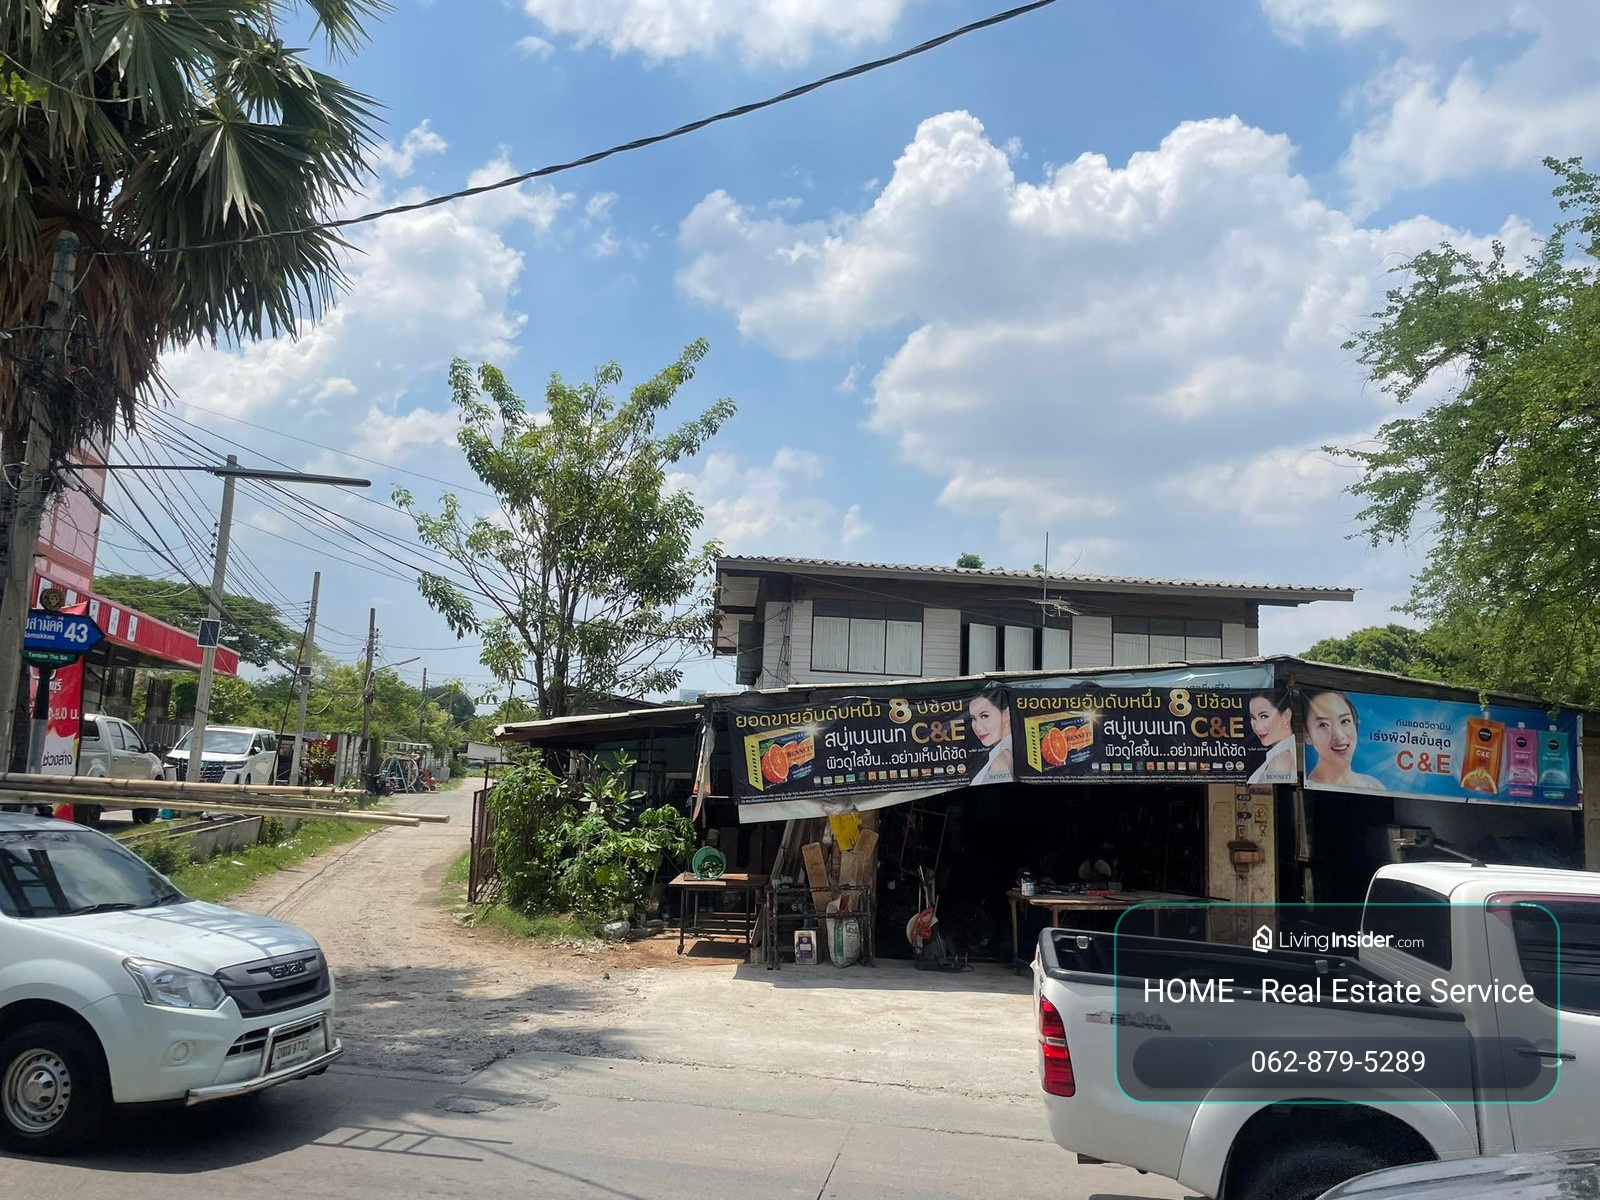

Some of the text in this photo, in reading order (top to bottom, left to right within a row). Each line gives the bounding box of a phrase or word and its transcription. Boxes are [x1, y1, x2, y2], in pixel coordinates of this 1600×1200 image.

[64, 622, 89, 643] 43
[735, 698, 963, 728] ยอดขายอันดับหนึ่ง 8 ปีซ้อน
[1016, 688, 1243, 717] ยอดขายอันดับหนึ่ง 8 ปีซ้อน
[824, 719, 966, 751] สบู่เบนเนท C&E
[1103, 716, 1245, 740] สบู่เบนเนท C&E
[1369, 729, 1451, 750] เร่งผิวใสขั้นสุด
[42, 751, 73, 767] ช่วงล่าง
[270, 960, 304, 977] ISUZU
